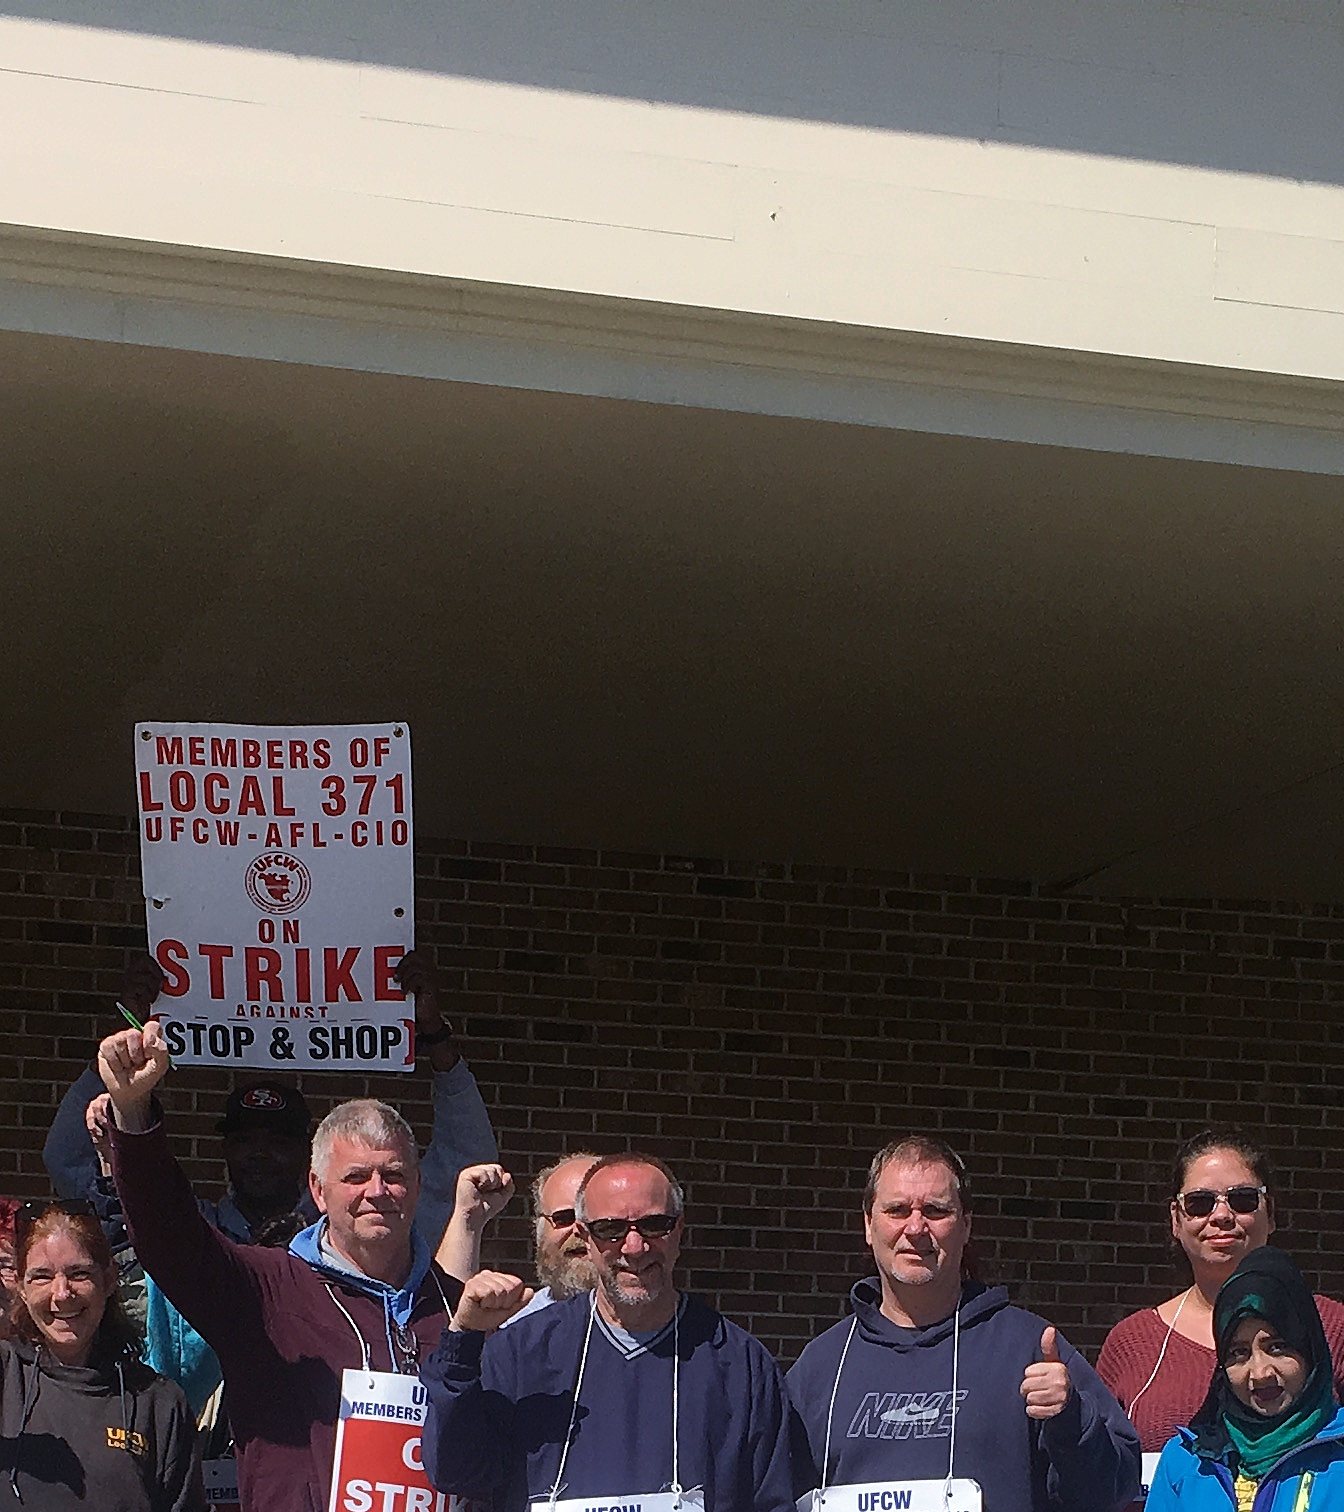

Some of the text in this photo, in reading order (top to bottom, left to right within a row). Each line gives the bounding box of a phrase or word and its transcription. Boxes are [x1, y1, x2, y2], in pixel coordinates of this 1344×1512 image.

[156, 736, 390, 769] MEMBERS OF
[140, 770, 404, 817] LOCAL 371
[145, 817, 409, 848] UFCW-AFL-CIO
[254, 855, 299, 871] UFCW
[258, 918, 300, 944] ON
[155, 939, 407, 1003] STRIKE
[236, 1004, 329, 1019] AGAINST
[165, 1022, 403, 1061] STOP & SHOP
[352, 1401, 422, 1421] MEMBERS
[846, 1389, 969, 1440] NIKE
[857, 1490, 912, 1512] UFCW
